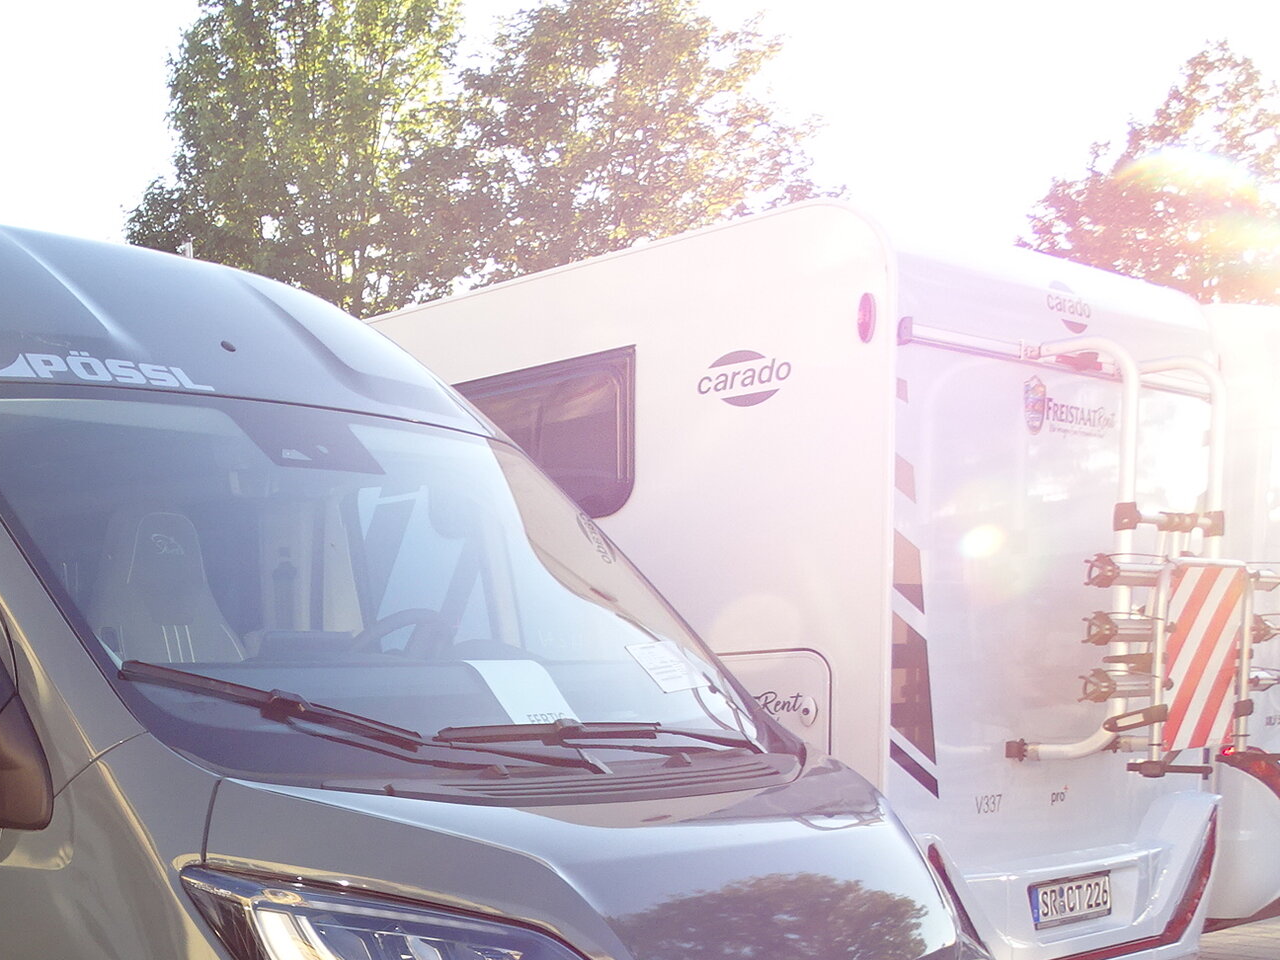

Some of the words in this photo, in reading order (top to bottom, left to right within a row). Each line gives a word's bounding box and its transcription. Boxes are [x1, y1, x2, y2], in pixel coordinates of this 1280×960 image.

[1047, 294, 1091, 319] carado
[24, 350, 216, 392] PÖSSL
[697, 357, 792, 395] carado
[754, 691, 803, 715] Rent
[975, 793, 1002, 814] V337
[1040, 889, 1059, 917] SR
[1065, 884, 1083, 912] CT
[1085, 880, 1108, 909] 226
